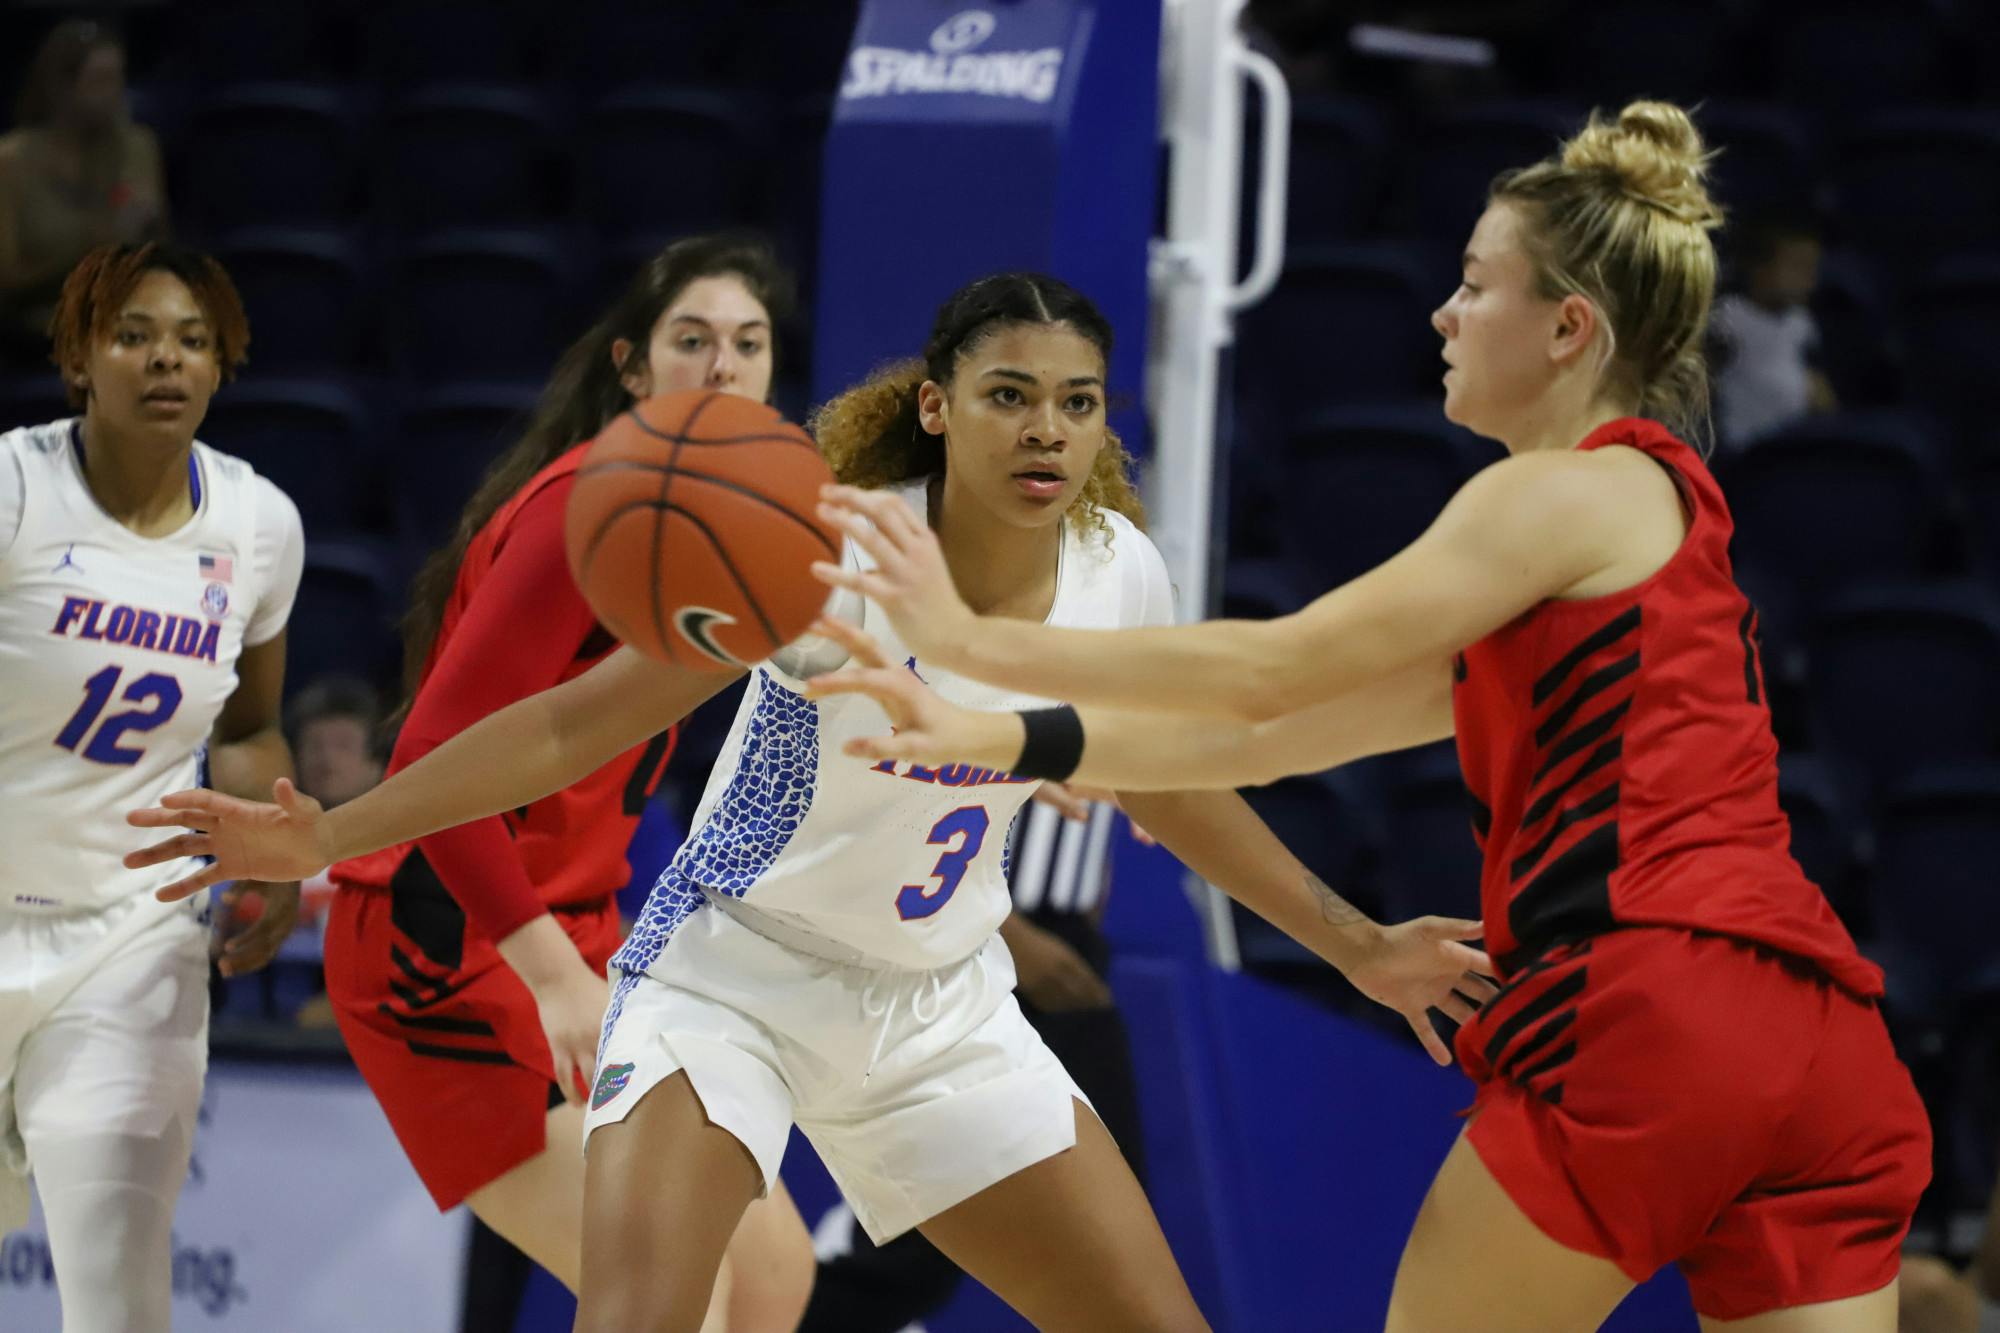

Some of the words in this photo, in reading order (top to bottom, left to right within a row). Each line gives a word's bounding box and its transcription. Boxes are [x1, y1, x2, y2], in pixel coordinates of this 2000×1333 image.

[842, 46, 1064, 102] SPALDING
[49, 594, 222, 665] FLORIDA
[53, 663, 183, 768] 12
[894, 804, 990, 922] 3
